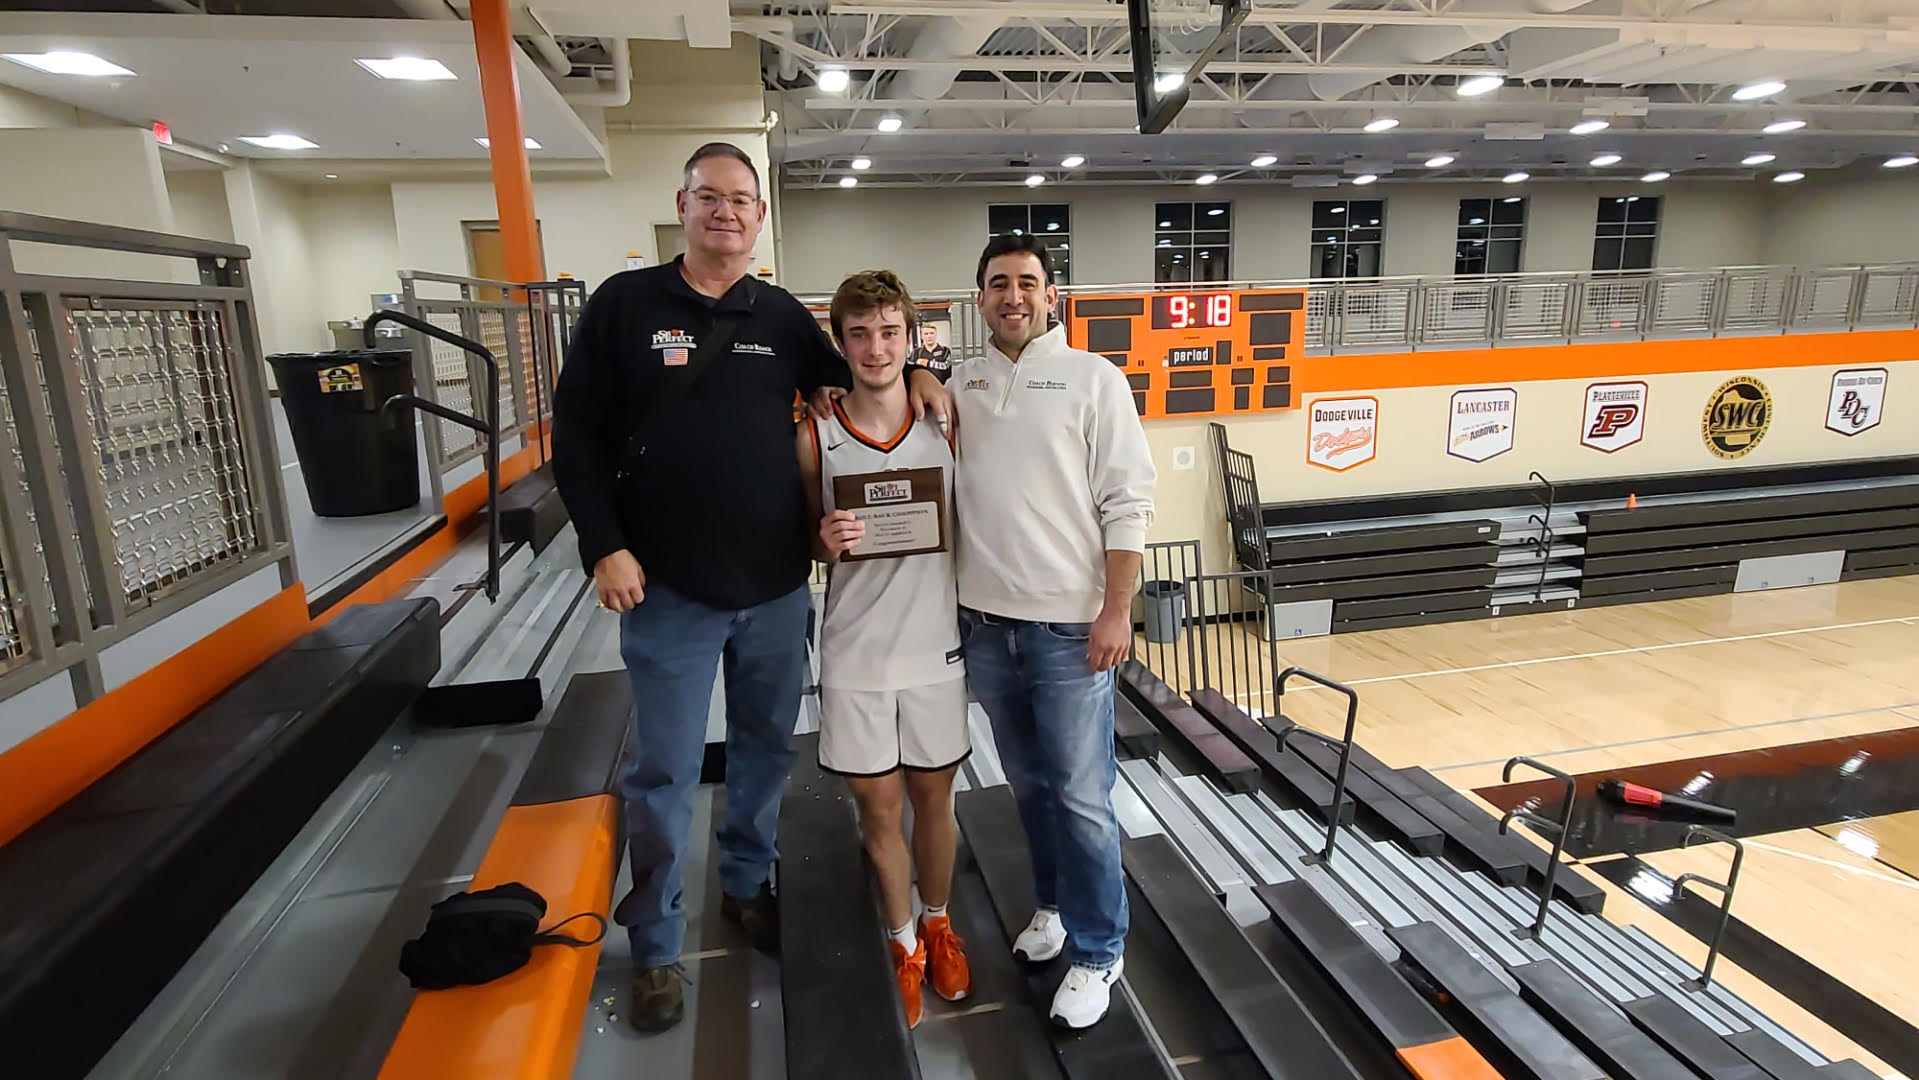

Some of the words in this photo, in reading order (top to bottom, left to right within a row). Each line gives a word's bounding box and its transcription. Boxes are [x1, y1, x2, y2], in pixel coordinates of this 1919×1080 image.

[1170, 295, 1231, 328] 9:18
[1173, 347, 1209, 365] period
[1593, 390, 1640, 402] PLATTEVILLE
[1315, 408, 1373, 422] DODGEVILLE
[1457, 400, 1510, 414] LANCASTER
[1711, 399, 1766, 430] SWC
[1837, 390, 1870, 428] PDC
[1587, 403, 1639, 438] P
[1469, 424, 1499, 441] ARROWS
